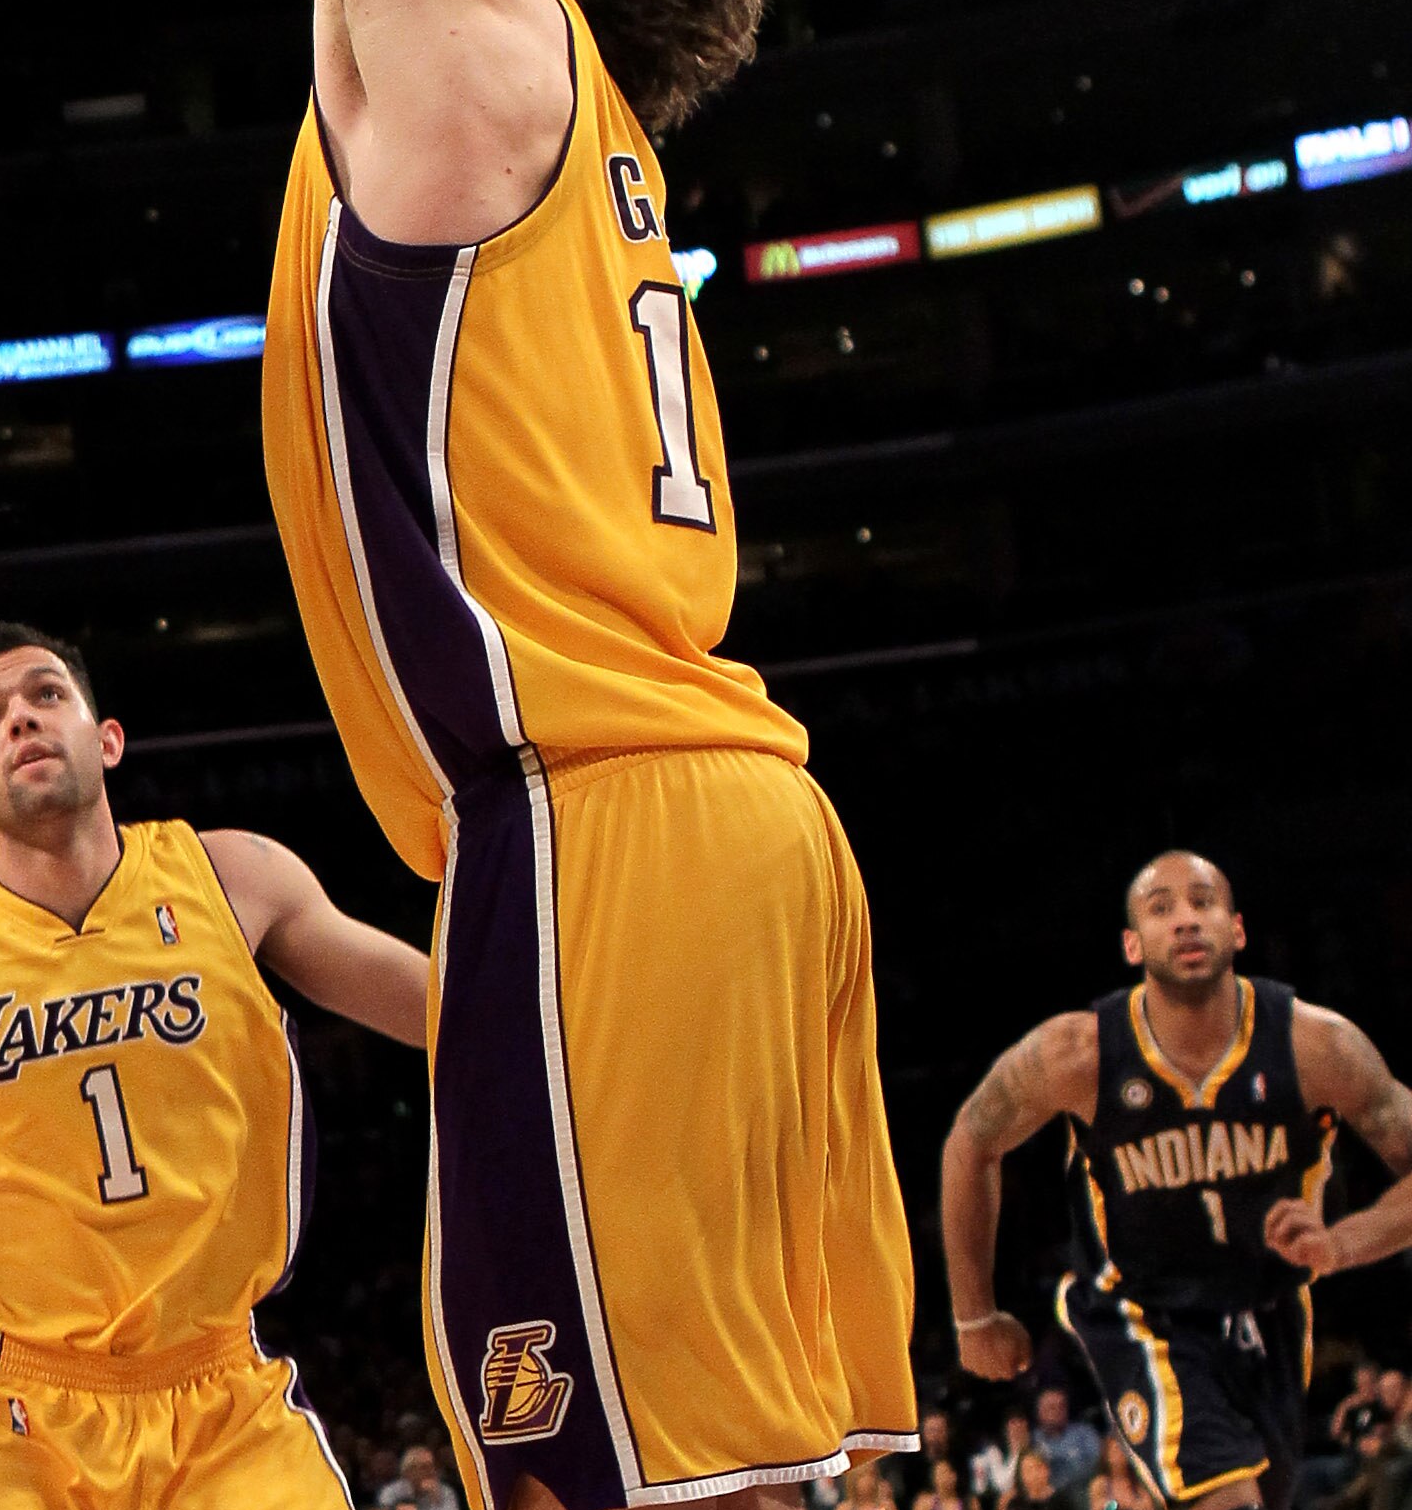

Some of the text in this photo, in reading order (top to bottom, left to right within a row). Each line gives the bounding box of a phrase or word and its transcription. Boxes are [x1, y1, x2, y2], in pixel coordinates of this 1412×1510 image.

[79, 1062, 150, 1205] 1
[1114, 1120, 1289, 1195] INDIANA
[1202, 1188, 1228, 1244] 1
